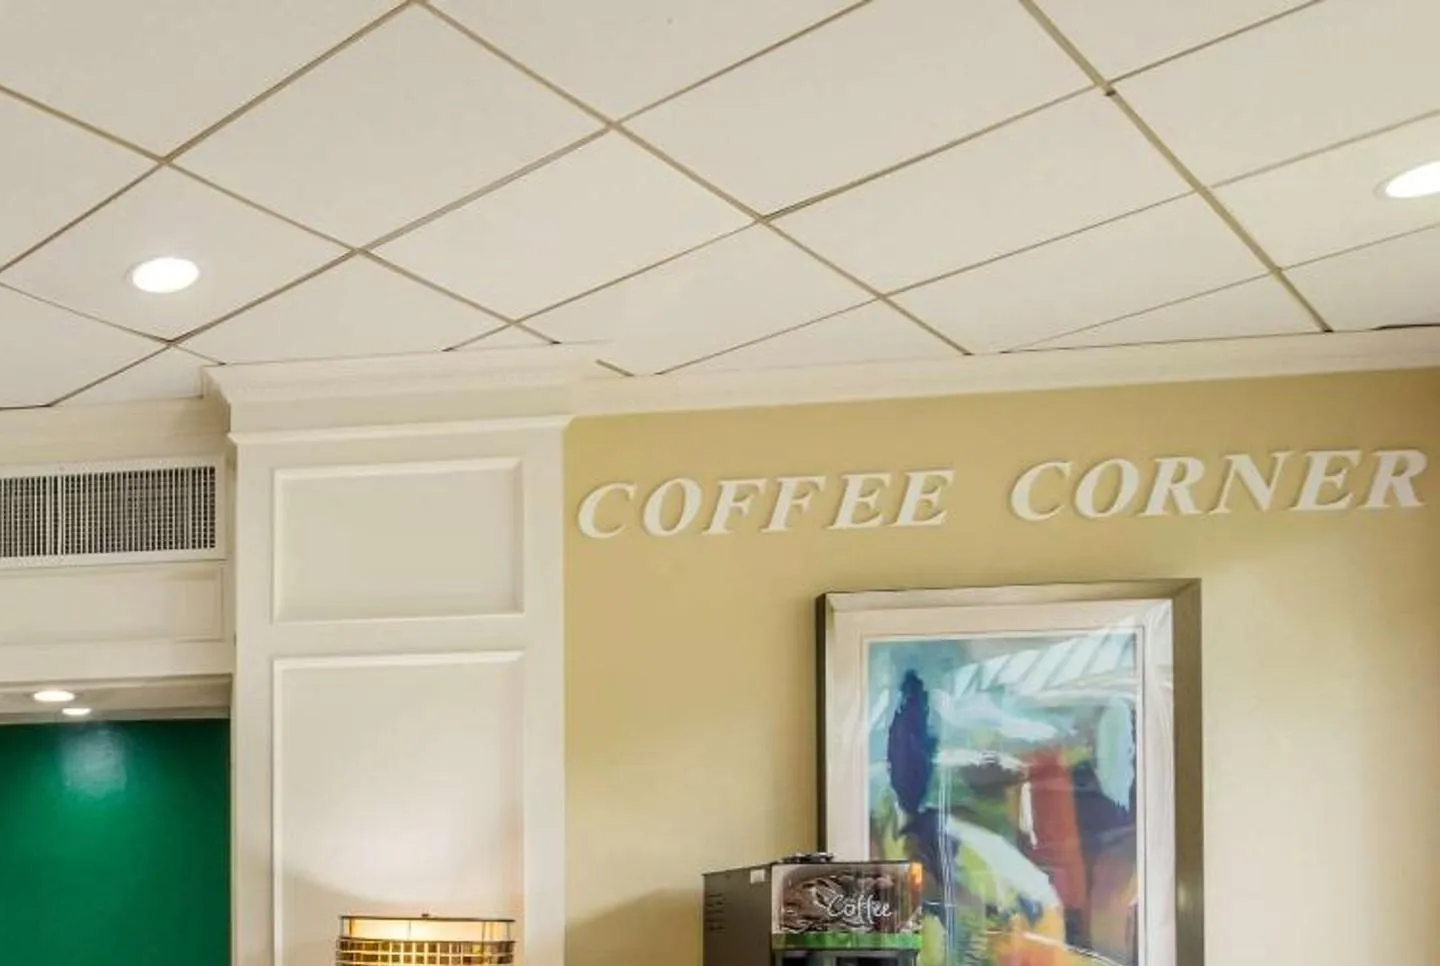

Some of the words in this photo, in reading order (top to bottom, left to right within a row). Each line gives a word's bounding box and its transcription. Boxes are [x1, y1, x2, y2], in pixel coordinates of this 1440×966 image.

[576, 469, 955, 539] COFFEE
[1009, 448, 1428, 522] CORNER
[828, 894, 892, 924] Coffee
